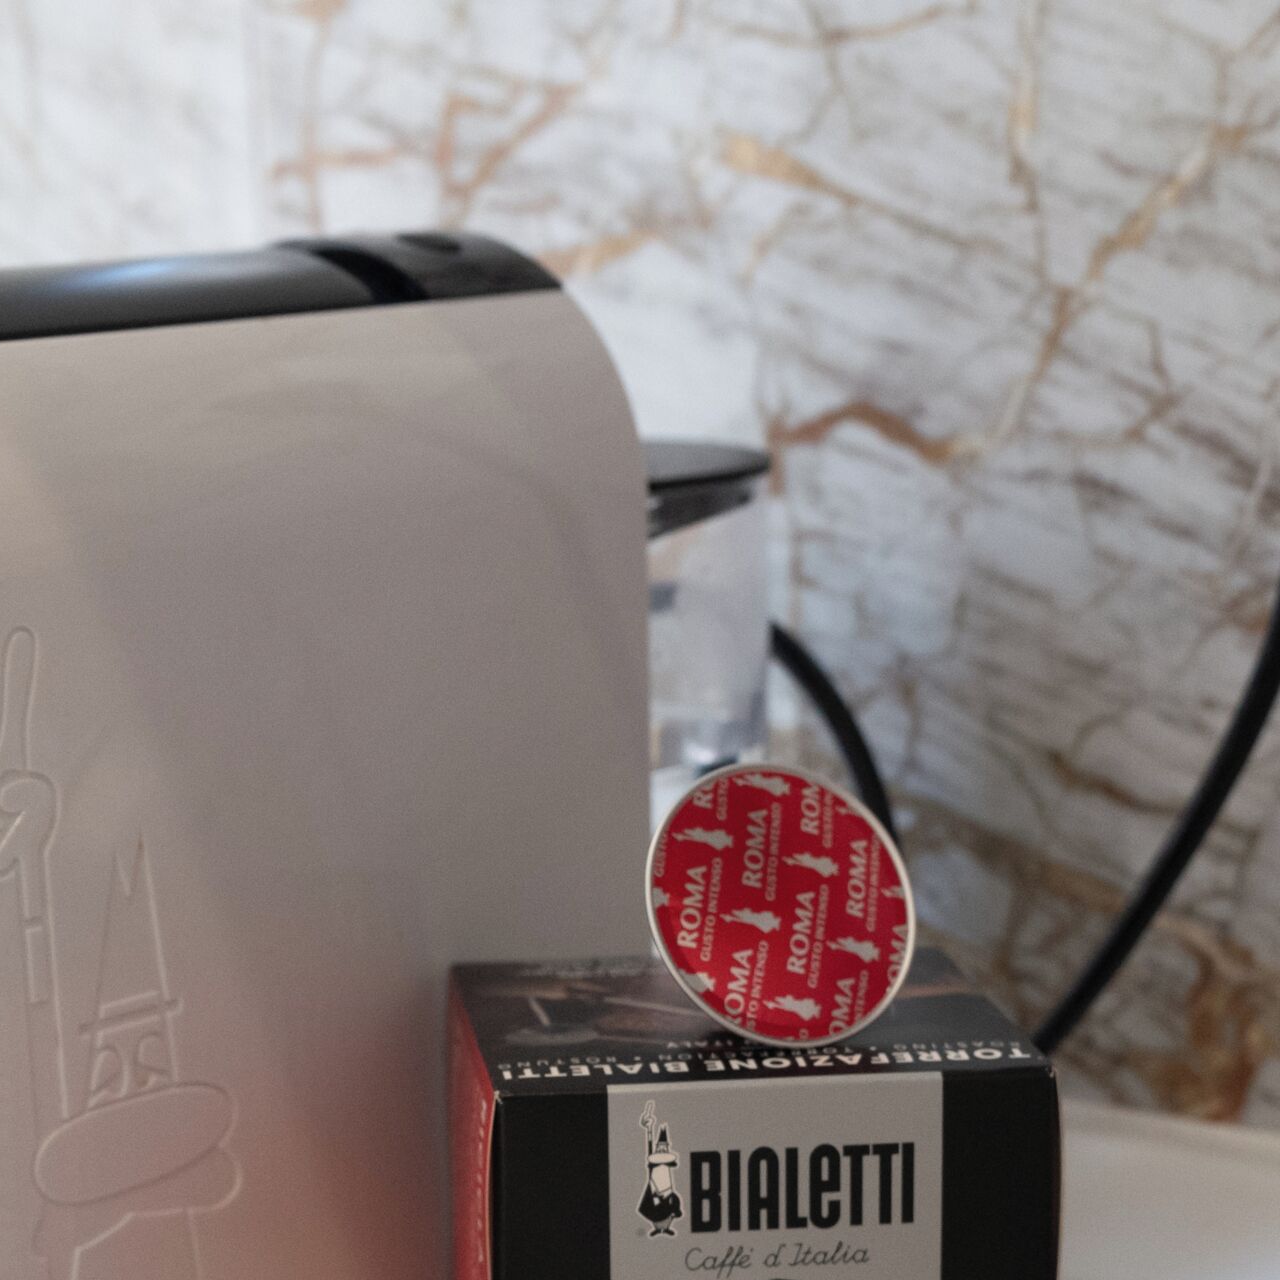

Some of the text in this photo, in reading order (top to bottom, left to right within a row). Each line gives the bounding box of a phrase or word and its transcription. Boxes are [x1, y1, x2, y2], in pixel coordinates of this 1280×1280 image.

[741, 809, 768, 888] ROMA
[800, 784, 820, 836] ROM
[765, 802, 781, 901] GUSTO INTENSO
[845, 839, 868, 918] ROMA
[677, 865, 707, 948] ROMA
[701, 857, 723, 962] GUSTO INTENSO
[786, 891, 816, 974] ROMA
[807, 884, 829, 988] GUSTO INTENSO
[750, 940, 768, 998] INTENSO
[829, 977, 856, 1036] OMA
[501, 1047, 1031, 1080] TORREFAZIONE BIALETTI
[690, 1142, 915, 1233] BIALETTI
